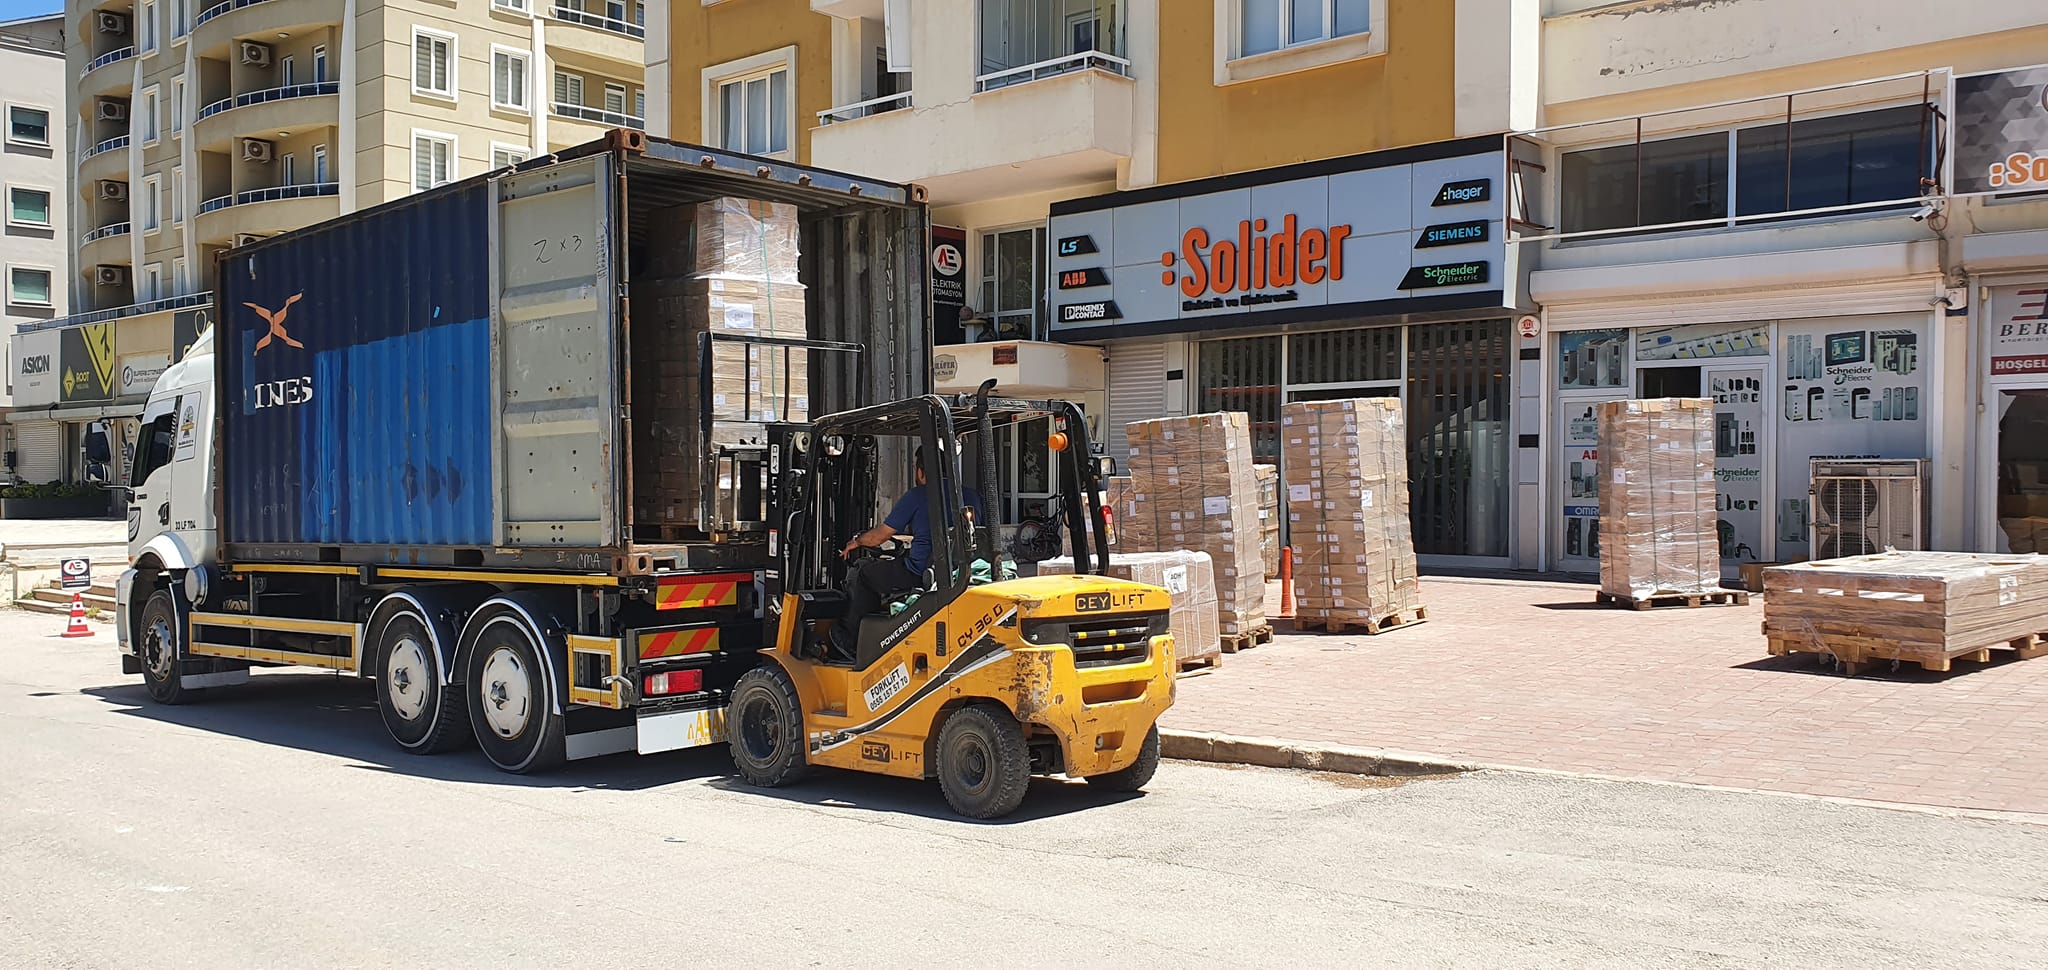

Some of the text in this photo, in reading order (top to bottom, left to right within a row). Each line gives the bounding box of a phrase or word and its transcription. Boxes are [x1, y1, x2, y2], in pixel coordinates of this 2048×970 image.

[1428, 226, 1481, 242] SIEMENS
[1061, 241, 1077, 254] LS
[1424, 264, 1479, 278] Schneider
[1063, 271, 1087, 287] ABB
[1447, 274, 1478, 282] Electric
[1075, 310, 1105, 319] CONTACT
[21, 354, 50, 374] ASKON
[75, 371, 90, 382] ROOT
[1826, 366, 1873, 375] Schneider
[1847, 374, 1873, 382] Electric
[1575, 506, 1599, 515] OMR
[880, 610, 922, 649] POWERSHIFT
[957, 627, 973, 648] CY
[993, 603, 1004, 618] D
[900, 675, 909, 686] 70
